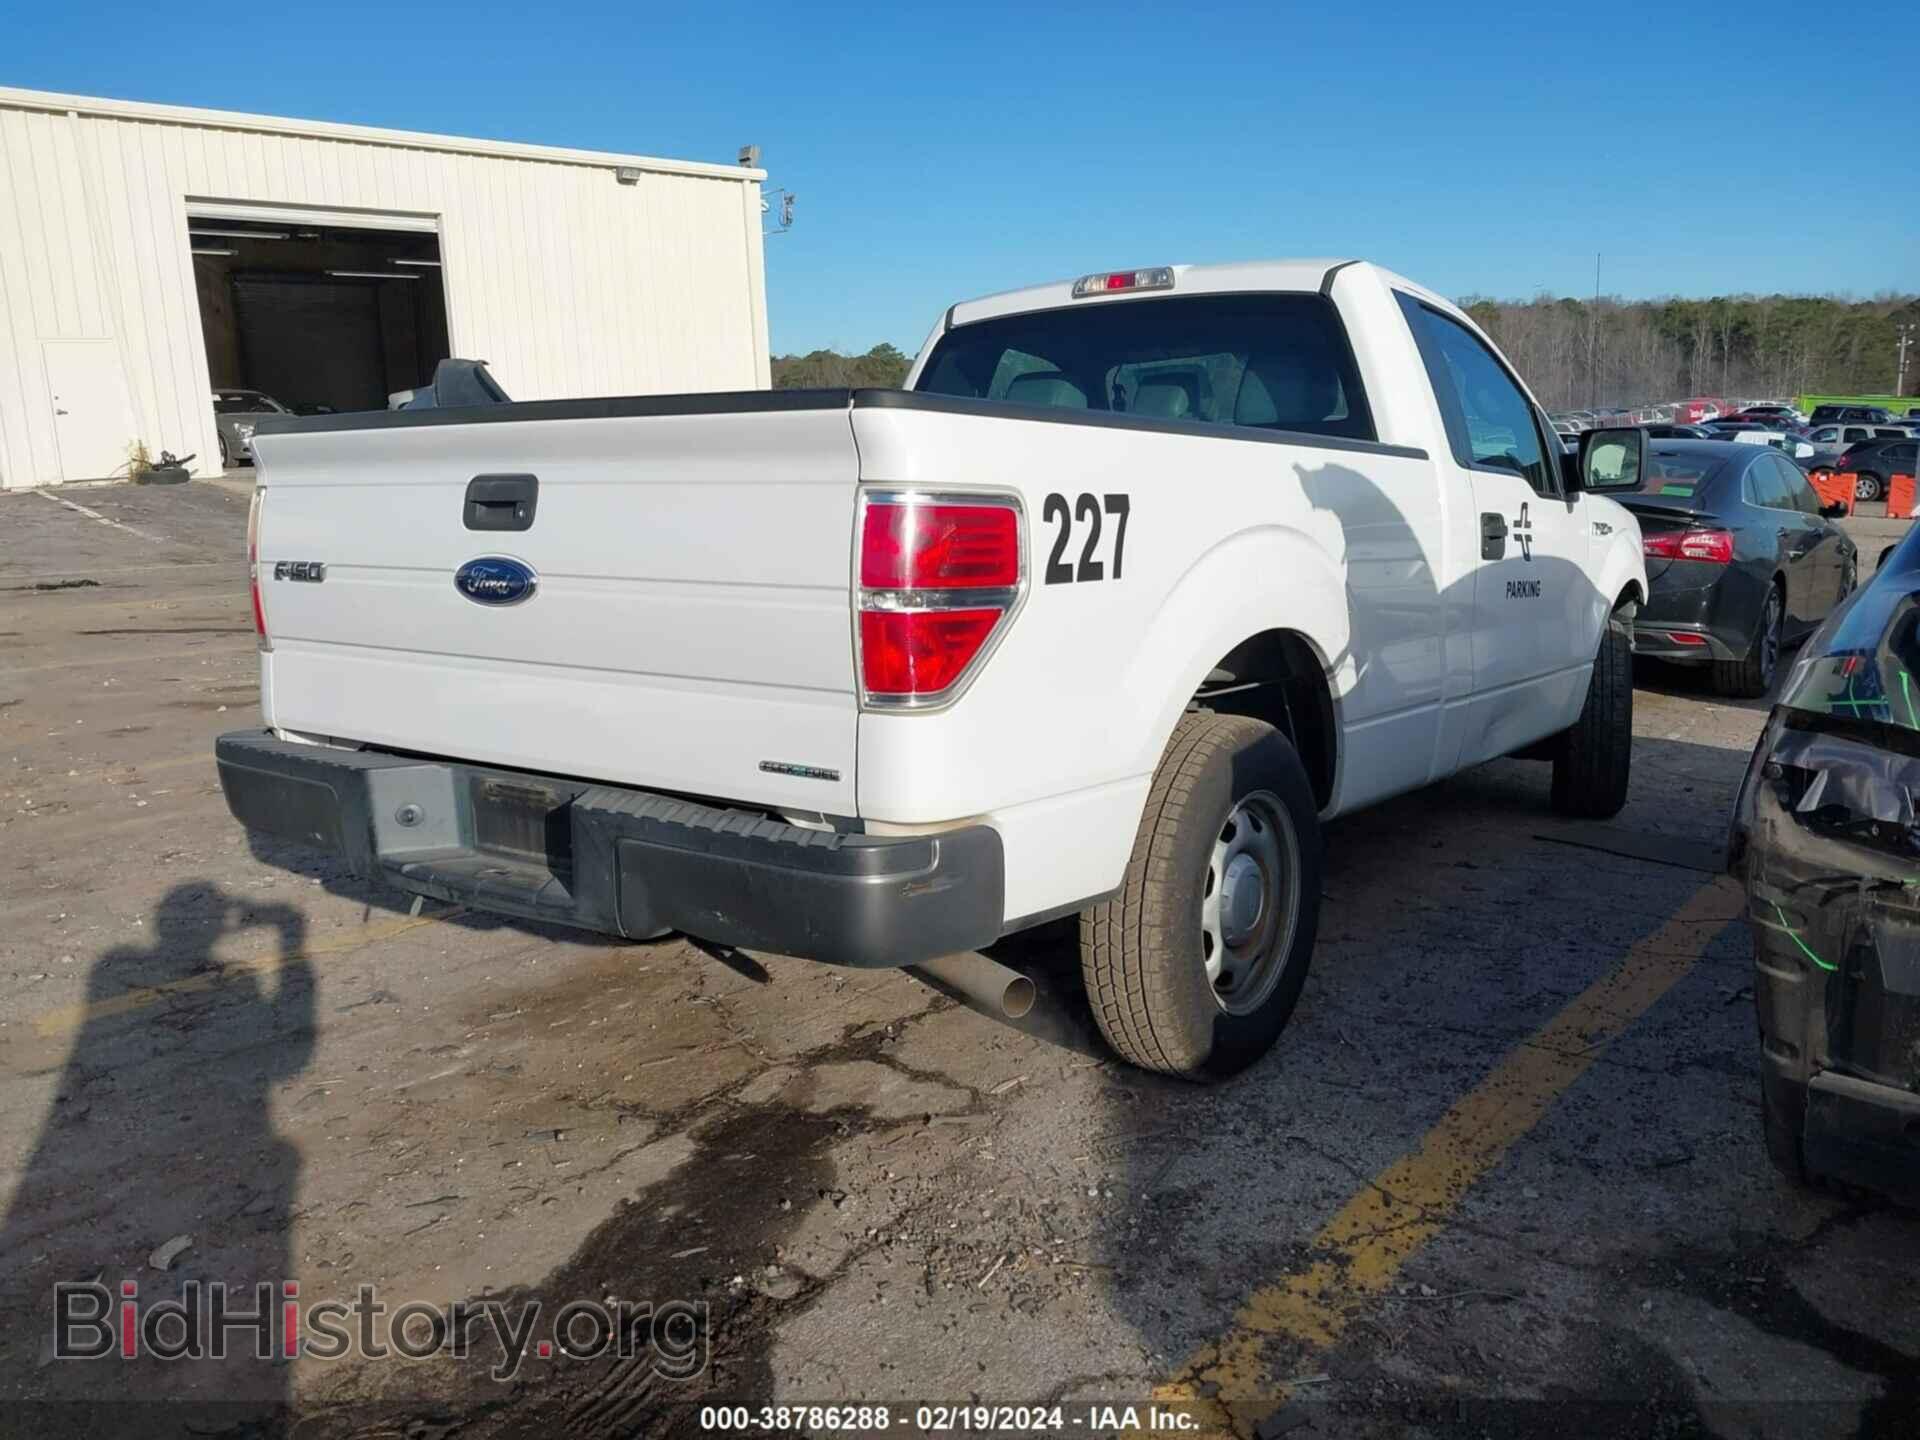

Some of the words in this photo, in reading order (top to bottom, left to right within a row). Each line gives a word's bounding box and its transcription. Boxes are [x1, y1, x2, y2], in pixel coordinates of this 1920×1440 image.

[1043, 492, 1130, 585] 227
[274, 560, 326, 583] F-150
[467, 566, 511, 594] Ford
[1506, 580, 1541, 599] PARKING
